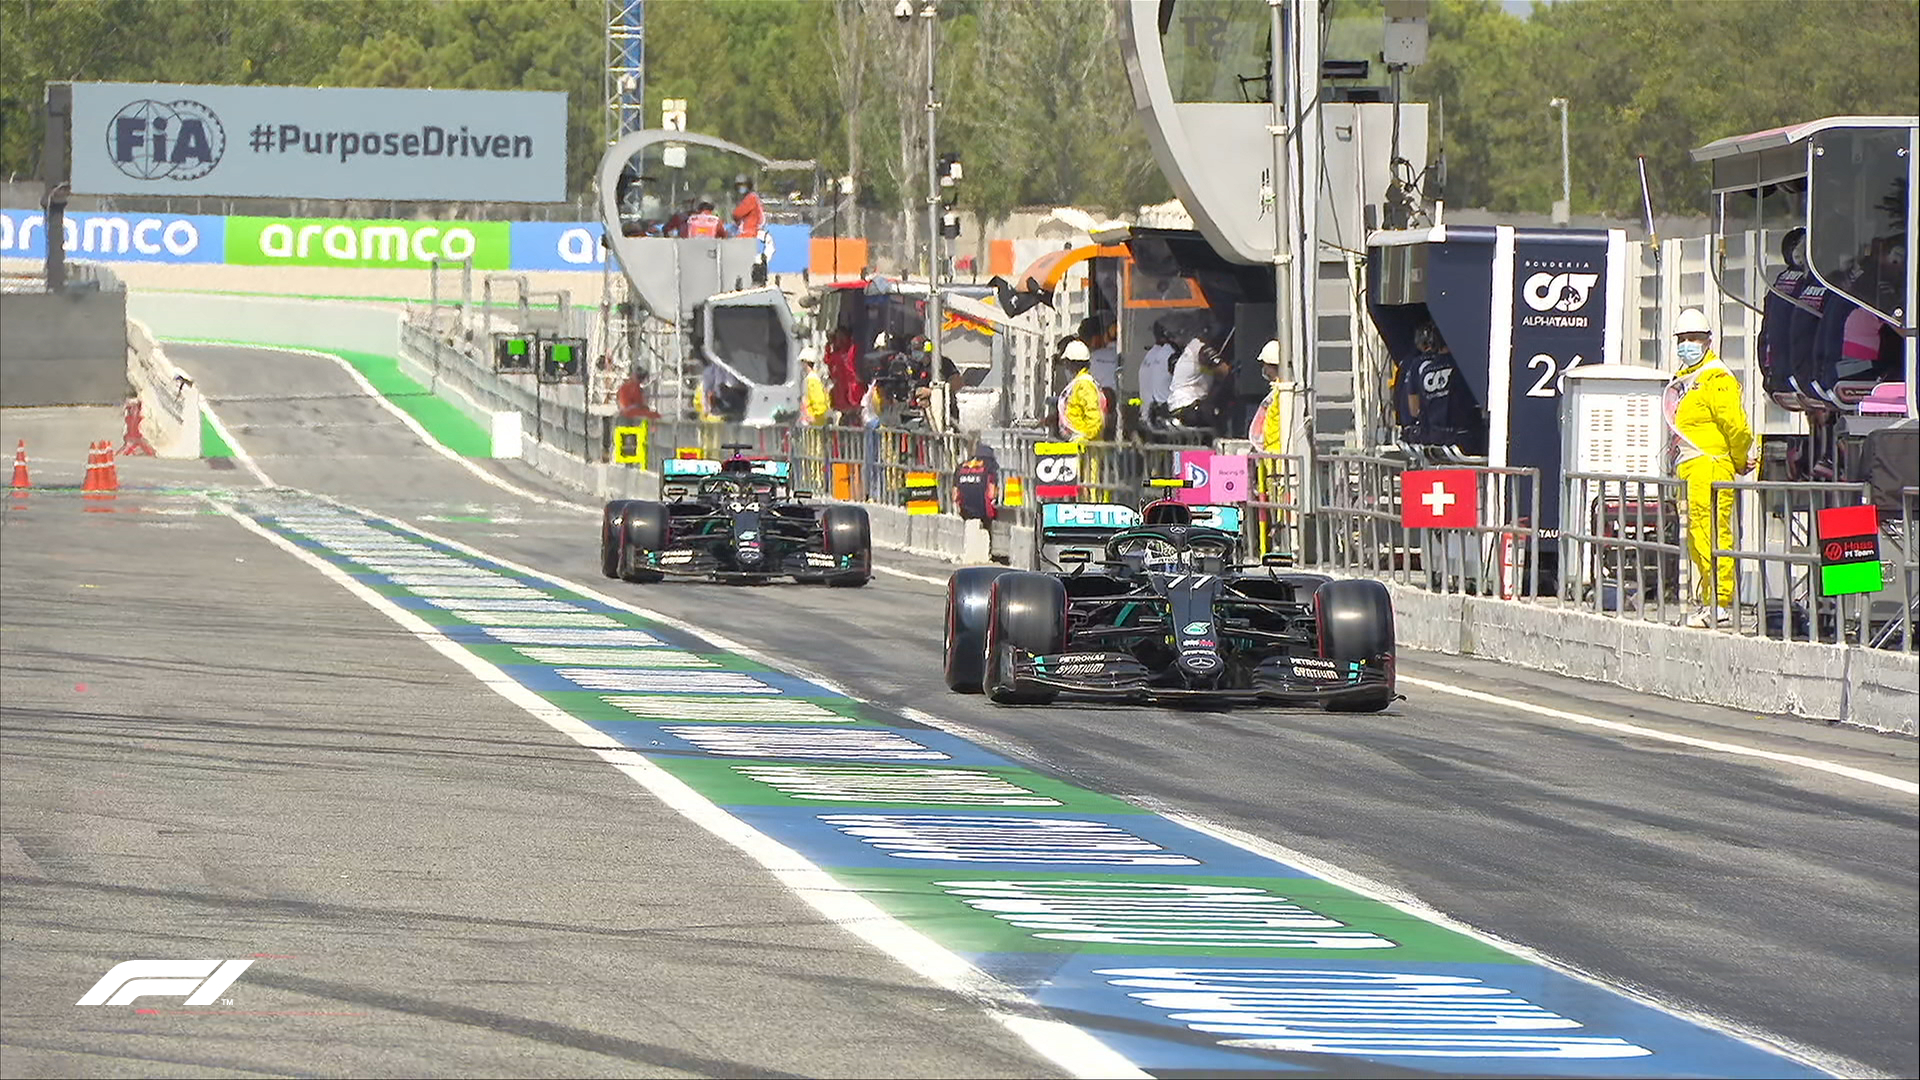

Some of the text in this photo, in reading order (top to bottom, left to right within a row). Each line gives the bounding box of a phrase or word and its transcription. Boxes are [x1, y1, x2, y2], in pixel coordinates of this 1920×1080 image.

[248, 124, 534, 164] #PurposeDriven
[259, 223, 476, 262] aramco
[1524, 260, 1590, 269] SCUDERIA
[1058, 654, 1106, 663] PETRONAS
[1290, 657, 1336, 668] PETRONAS
